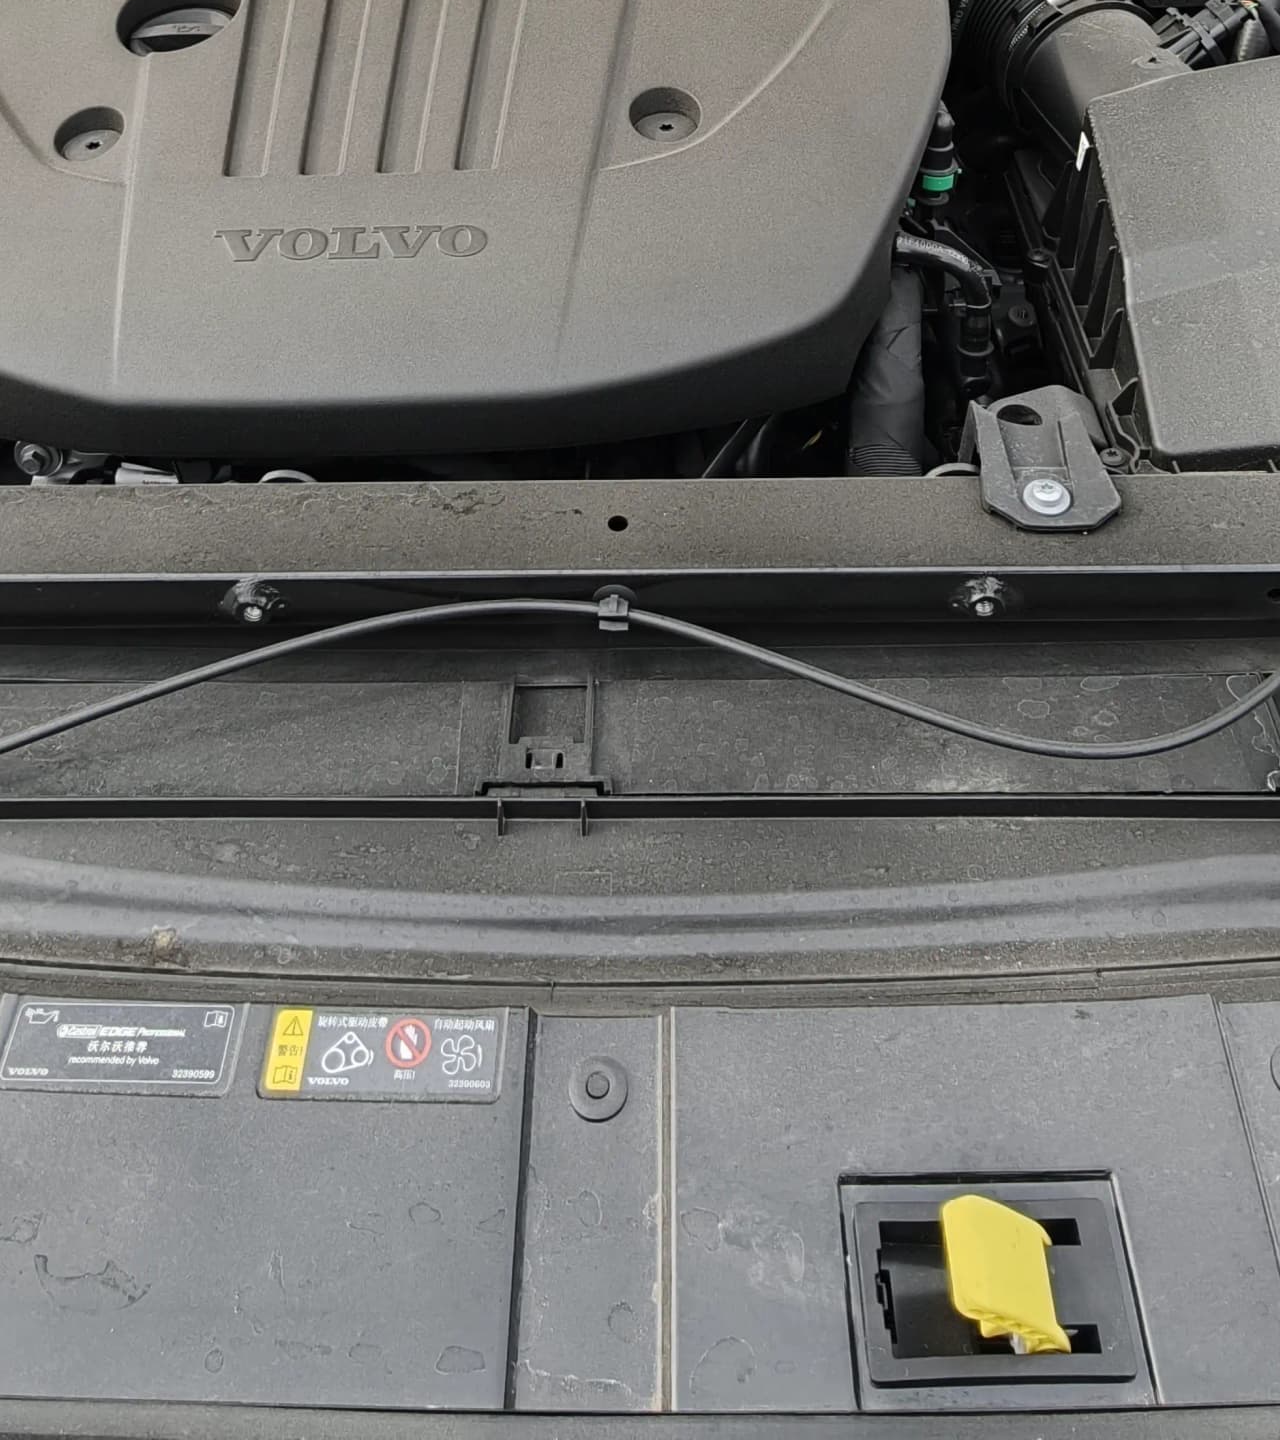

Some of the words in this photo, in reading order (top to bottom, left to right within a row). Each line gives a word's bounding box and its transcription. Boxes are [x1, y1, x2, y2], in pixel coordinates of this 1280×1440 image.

[214, 224, 488, 262] VOLVO
[98, 1026, 139, 1037] EDGE
[87, 1040, 148, 1053] 沃尔沃推荐
[67, 1055, 125, 1065] recommended
[126, 1056, 137, 1067] by
[138, 1056, 160, 1065] Volvo
[7, 1067, 49, 1076] VOLVO
[307, 1077, 350, 1086] VOLVO
